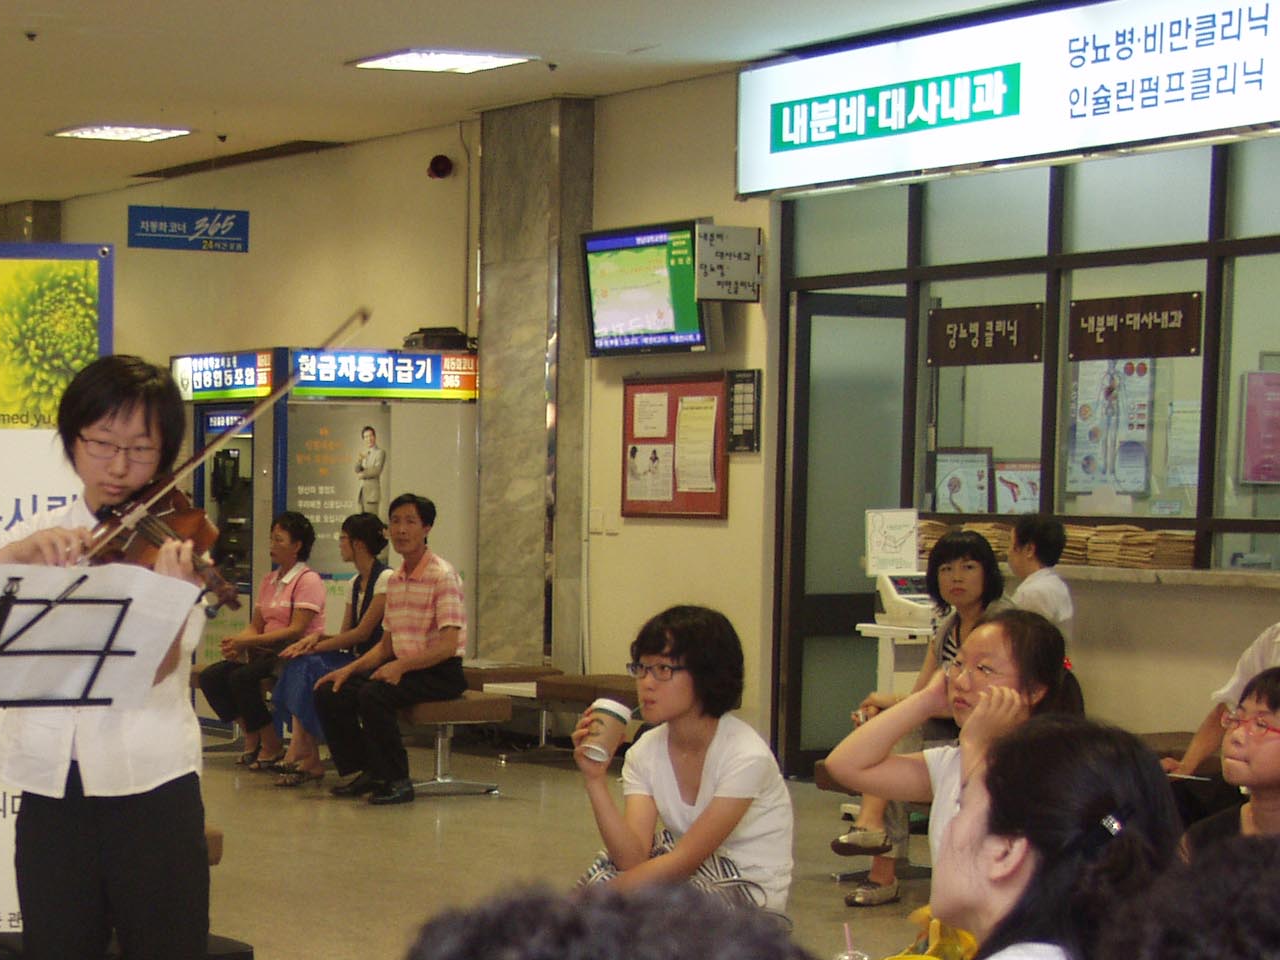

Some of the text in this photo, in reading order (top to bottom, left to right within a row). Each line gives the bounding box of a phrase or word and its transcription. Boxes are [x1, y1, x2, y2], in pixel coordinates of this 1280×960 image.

[1068, 3, 1269, 69] 당뇨병·비만클리닉
[1069, 57, 1265, 119] 인슐린펌프클리닉
[781, 70, 1007, 145] 내분비·대사내과
[188, 213, 236, 241] 365
[946, 319, 1019, 349] 당뇨병 클리닉
[1081, 310, 1184, 343] 내분비·대사내과
[298, 354, 432, 384] 현금자동지급기
[443, 374, 460, 388] 365
